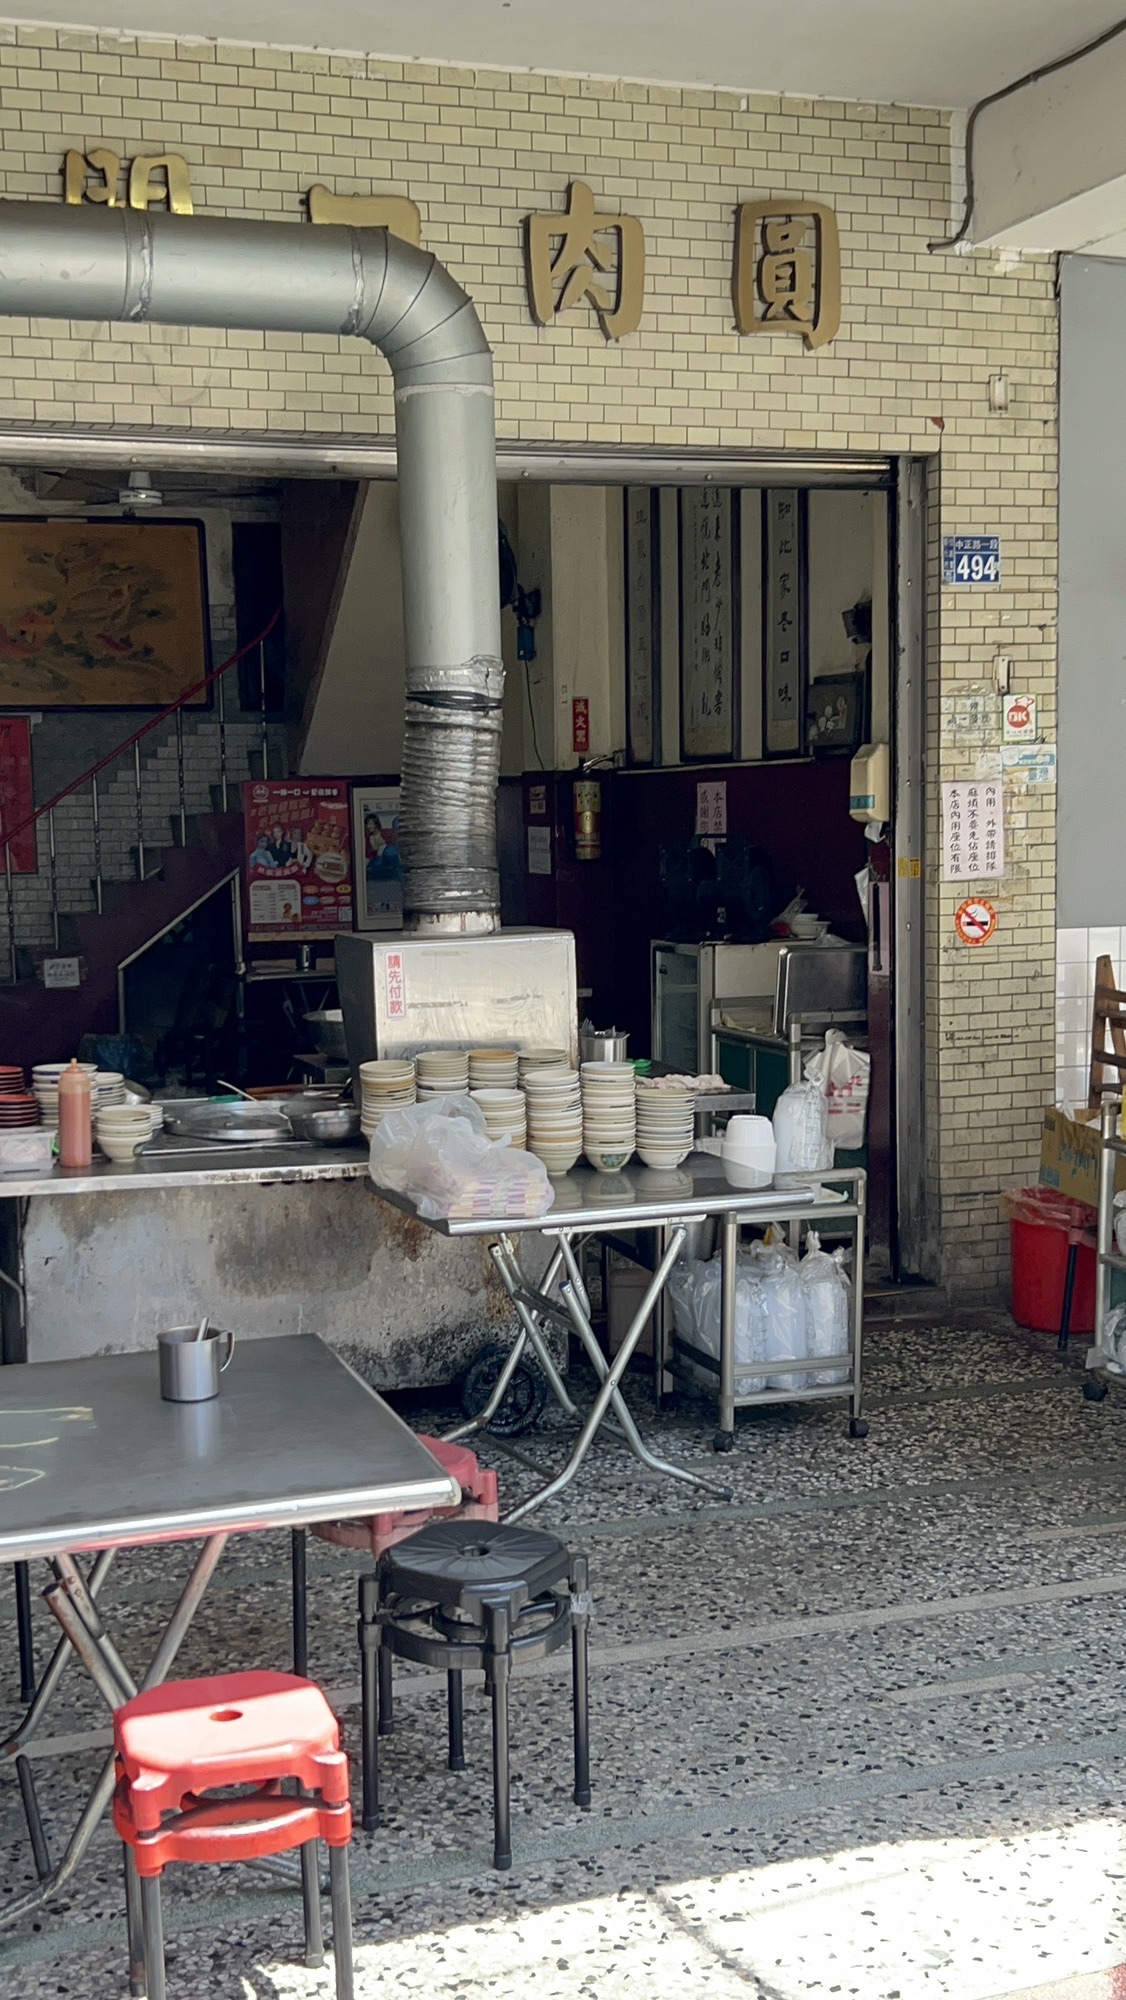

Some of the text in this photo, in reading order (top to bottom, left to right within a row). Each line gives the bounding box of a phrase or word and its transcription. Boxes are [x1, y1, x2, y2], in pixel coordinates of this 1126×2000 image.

[955, 539, 998, 550] 中正路一段
[957, 554, 997, 581] 494
[387, 954, 403, 1015] 請先付款
